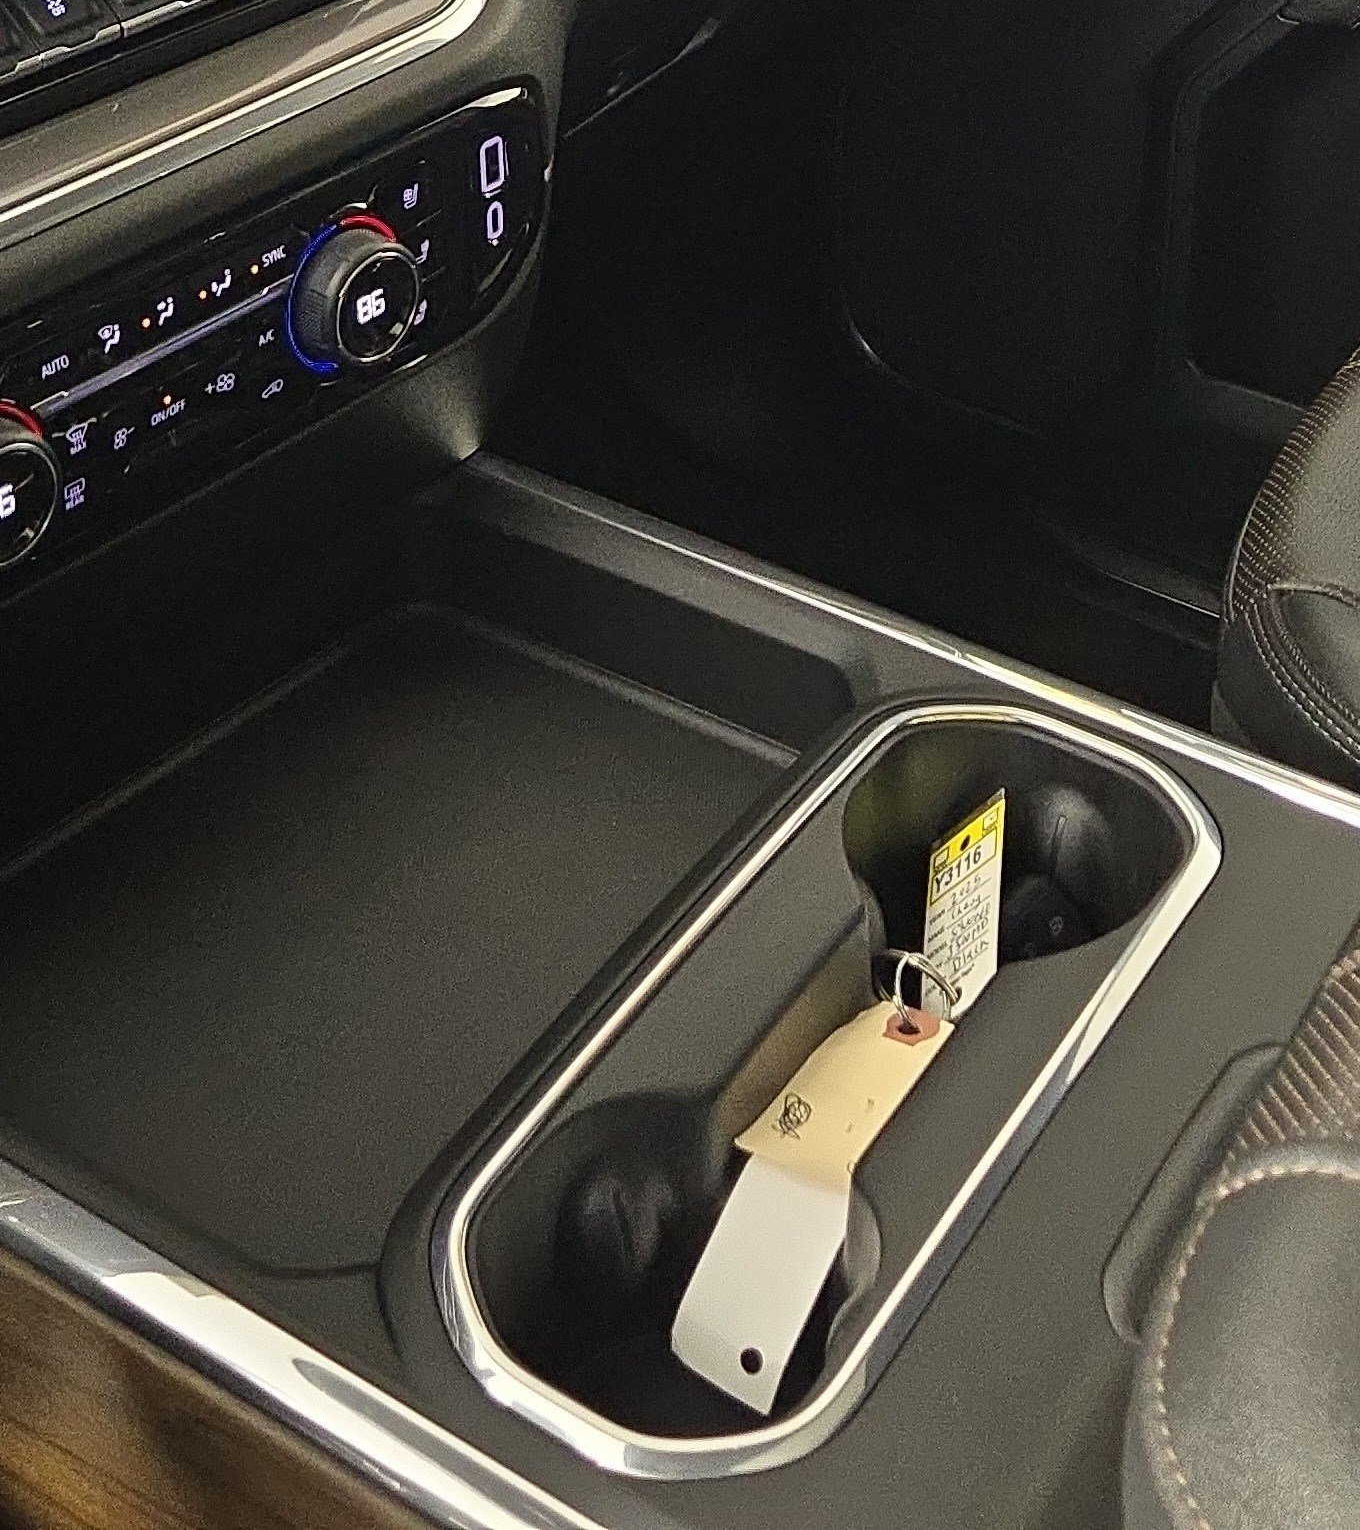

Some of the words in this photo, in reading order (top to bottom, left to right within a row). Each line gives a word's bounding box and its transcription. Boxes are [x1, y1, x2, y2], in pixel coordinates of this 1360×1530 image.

[262, 245, 287, 267] SYNC
[356, 288, 386, 325] 86
[259, 329, 275, 346] A/C
[42, 354, 70, 379] AUTO
[151, 398, 186, 426] ON/OFF
[936, 845, 982, 894] Y3116
